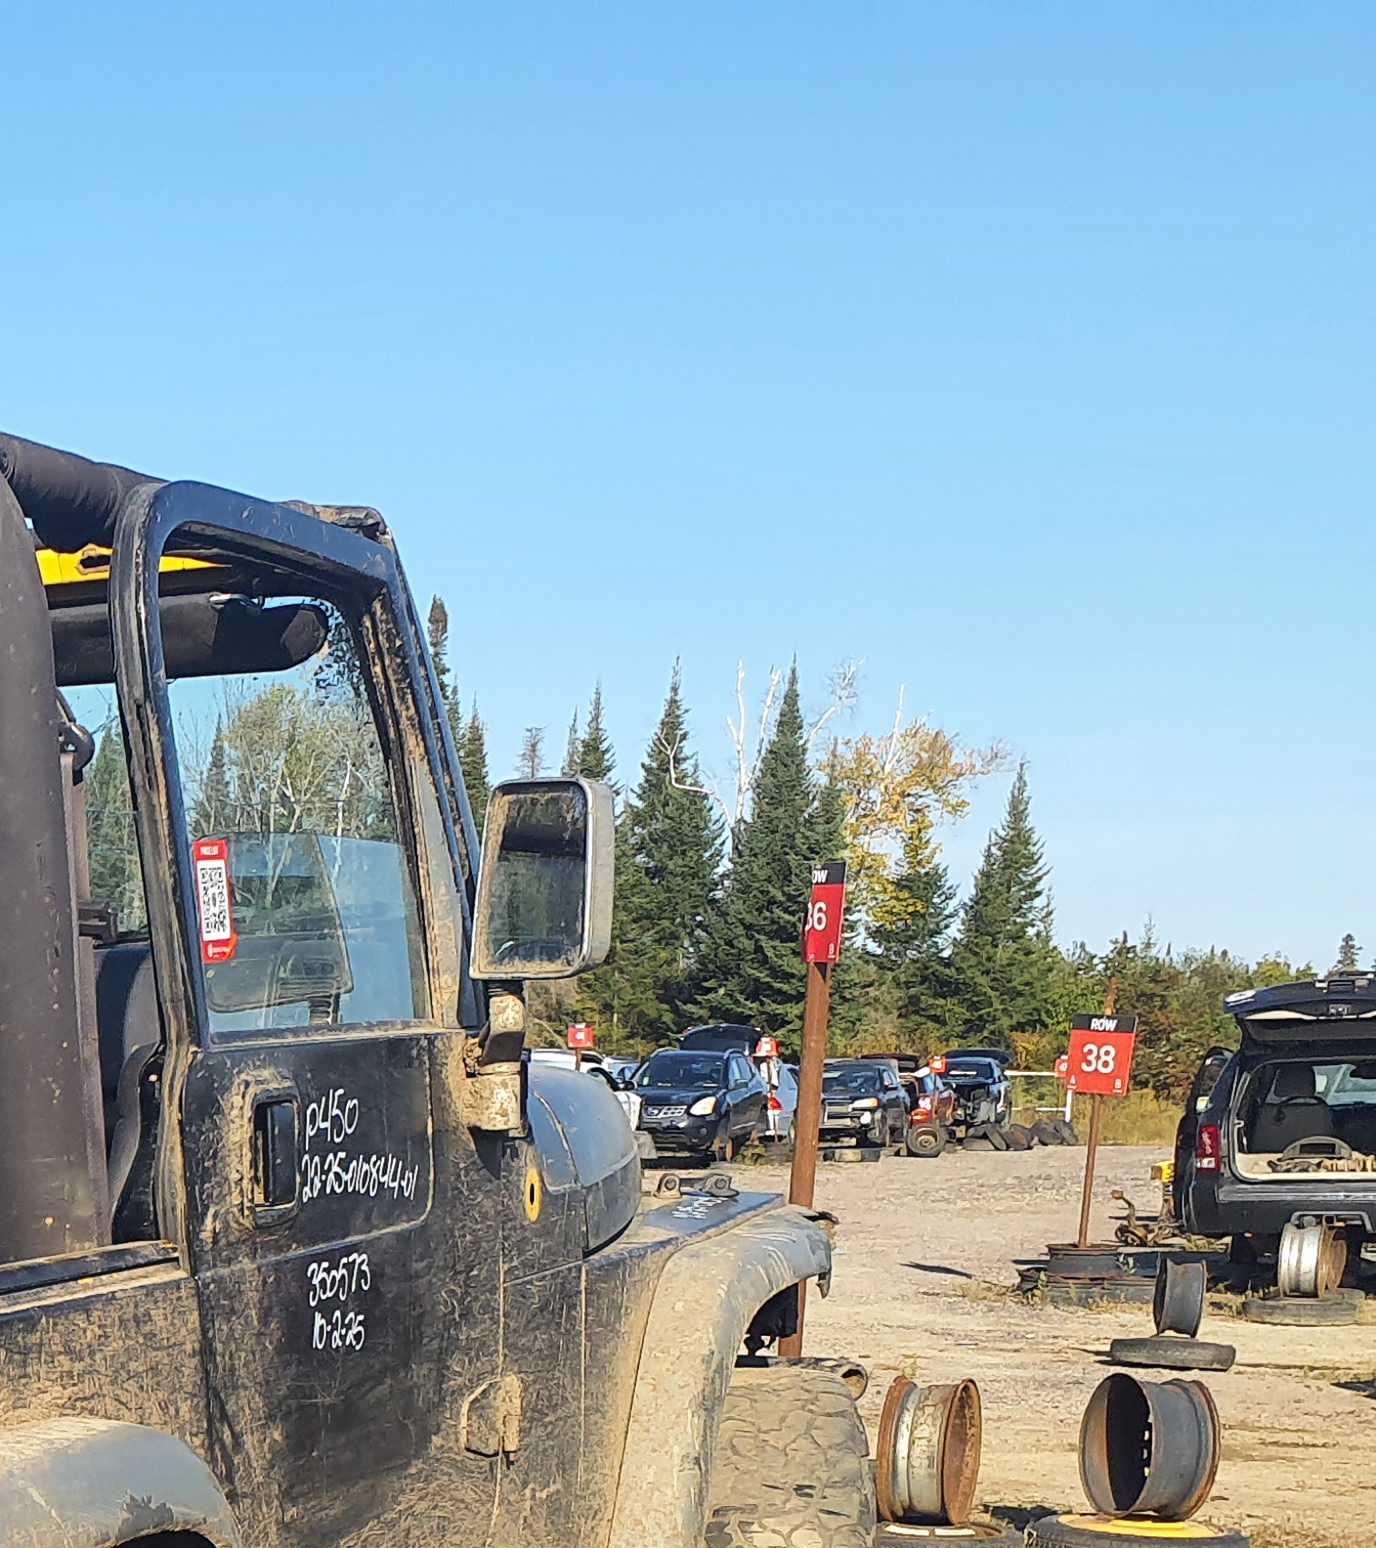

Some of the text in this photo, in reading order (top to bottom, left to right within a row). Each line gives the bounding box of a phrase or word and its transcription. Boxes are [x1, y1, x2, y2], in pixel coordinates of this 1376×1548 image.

[811, 869, 827, 883] OW
[1090, 1018, 1117, 1031] ROW
[1081, 1043, 1116, 1074] 38
[307, 1252, 371, 1307] 350573
